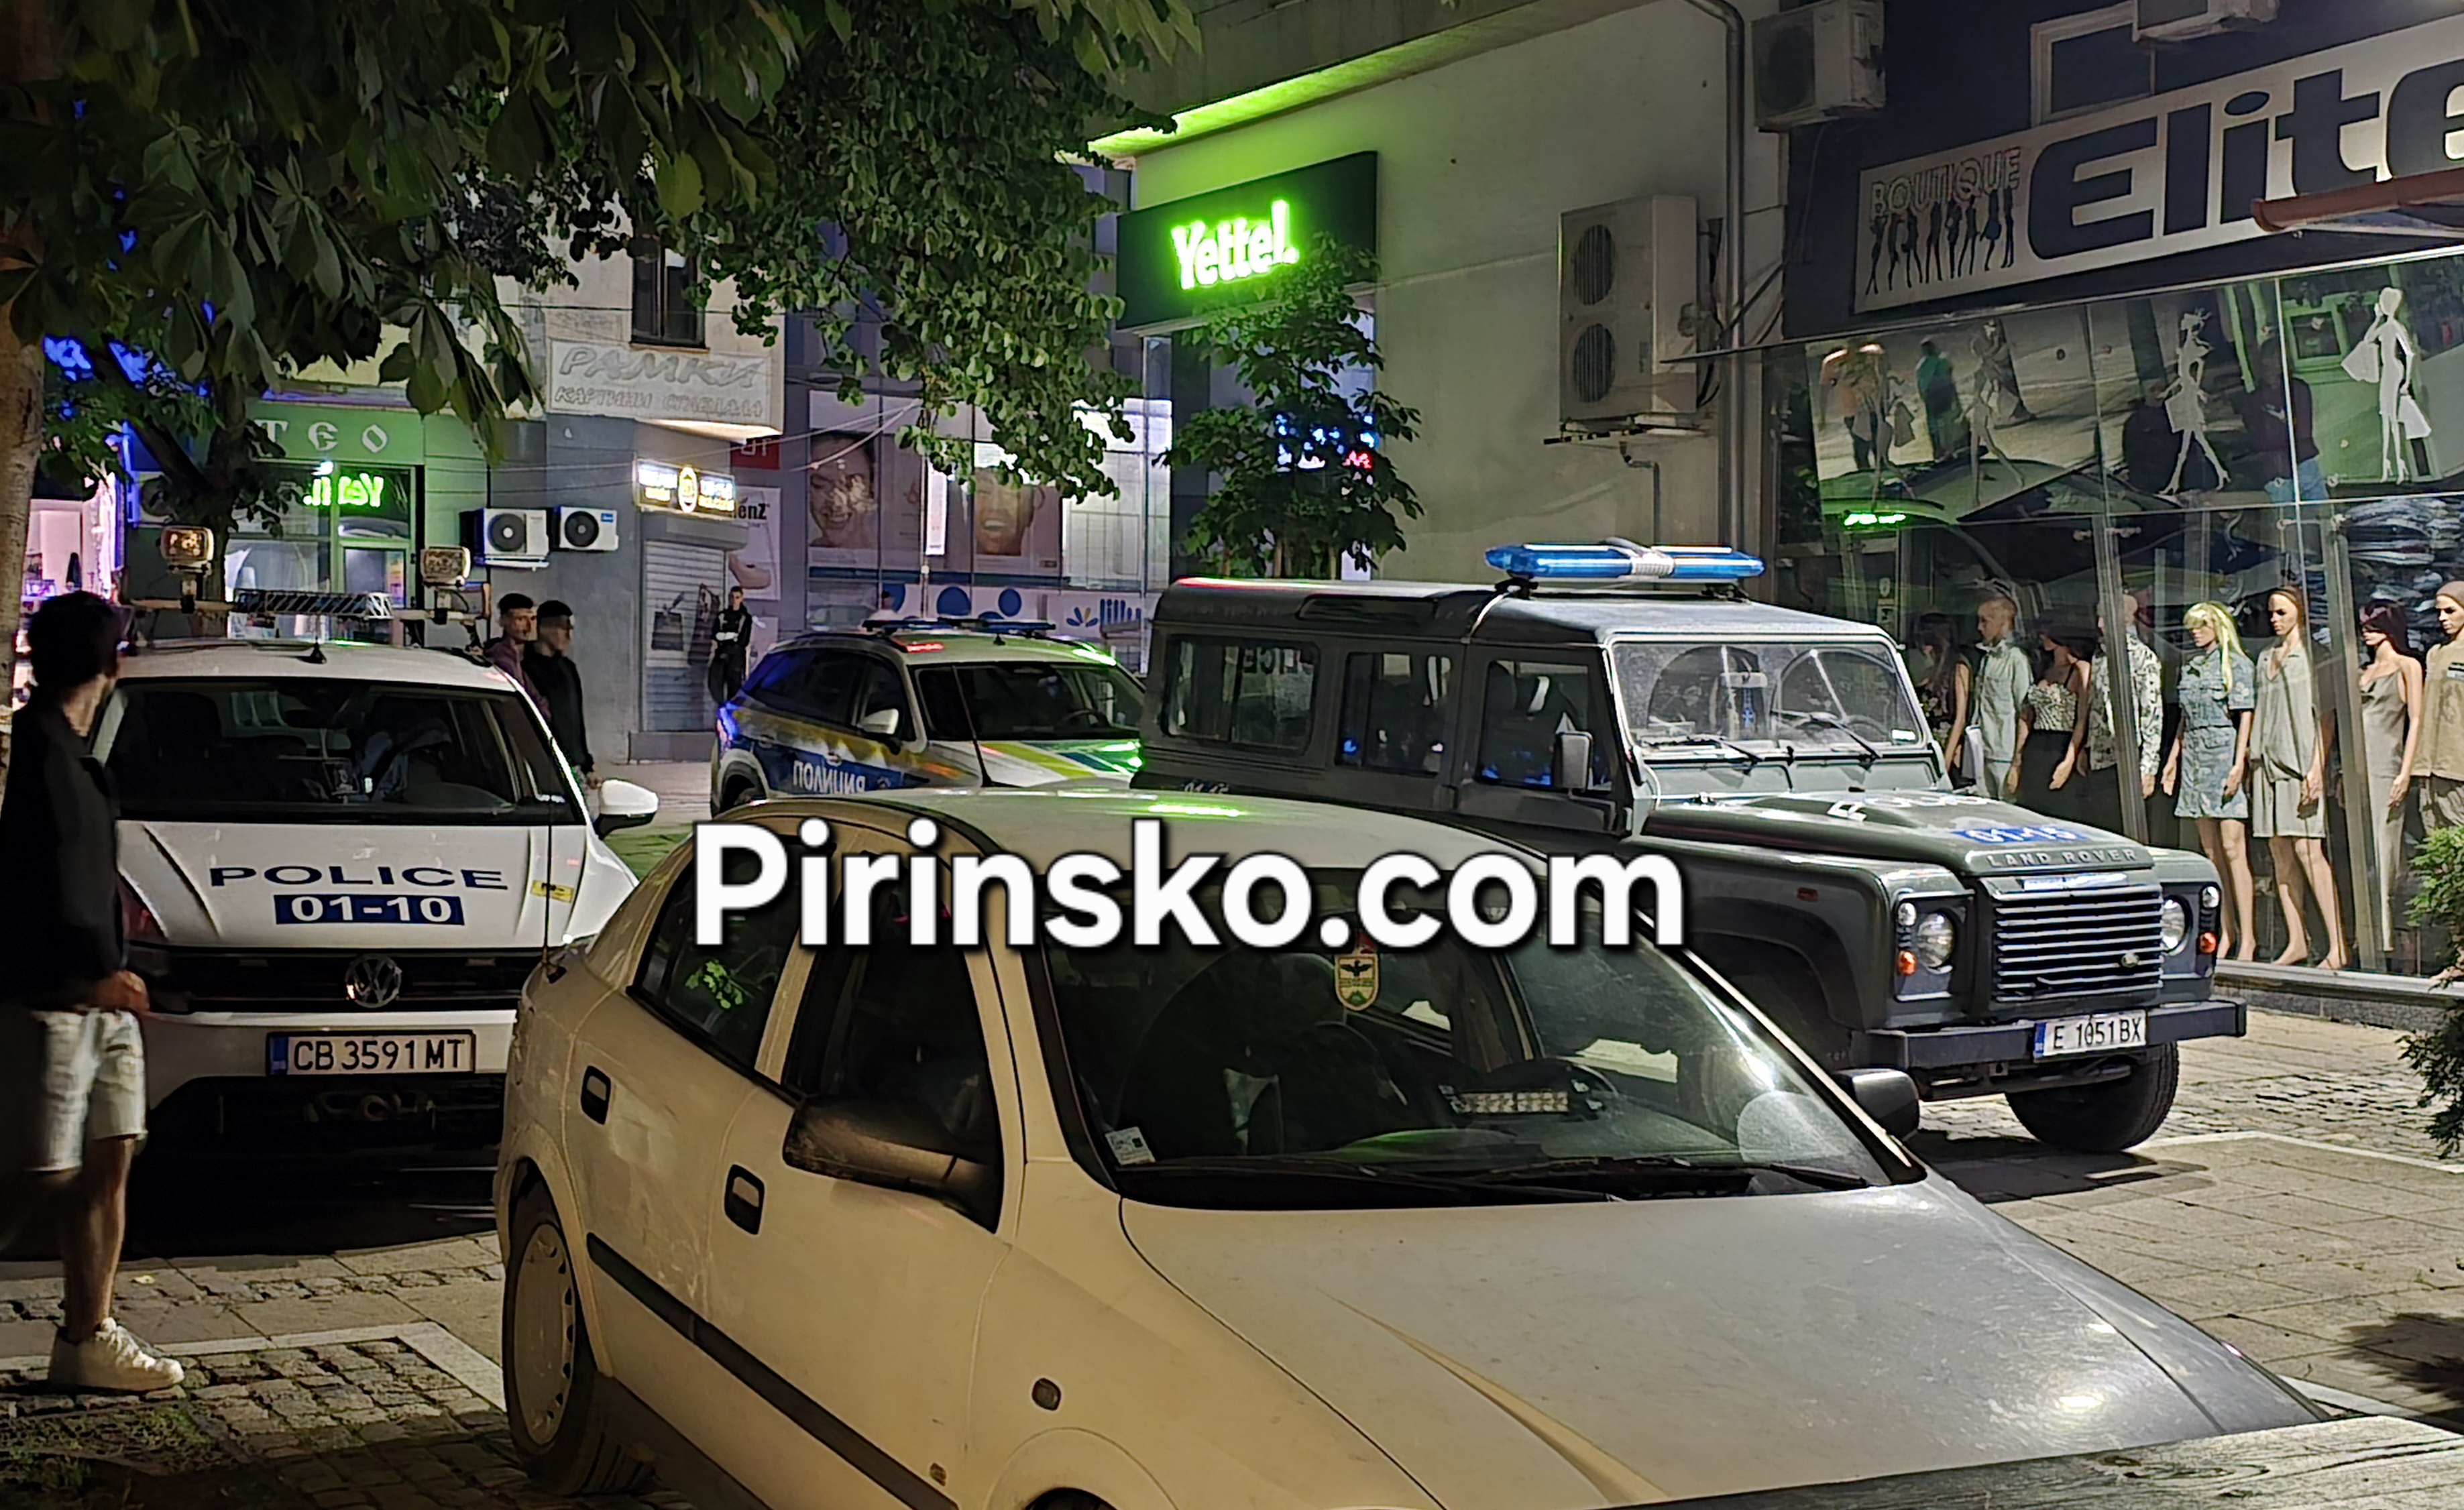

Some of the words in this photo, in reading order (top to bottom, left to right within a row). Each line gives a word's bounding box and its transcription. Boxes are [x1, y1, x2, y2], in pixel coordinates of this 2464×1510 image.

[1870, 146, 2021, 217] BOUTIQUE
[559, 346, 764, 389] РАМКИ
[555, 386, 652, 409] КАРТИНИ
[793, 760, 866, 795] ПОЛИЦИЯ
[1986, 852, 2052, 868] LAND
[2063, 848, 2137, 864] ROVER
[210, 866, 508, 890] POLICE
[291, 896, 452, 921] 01-10
